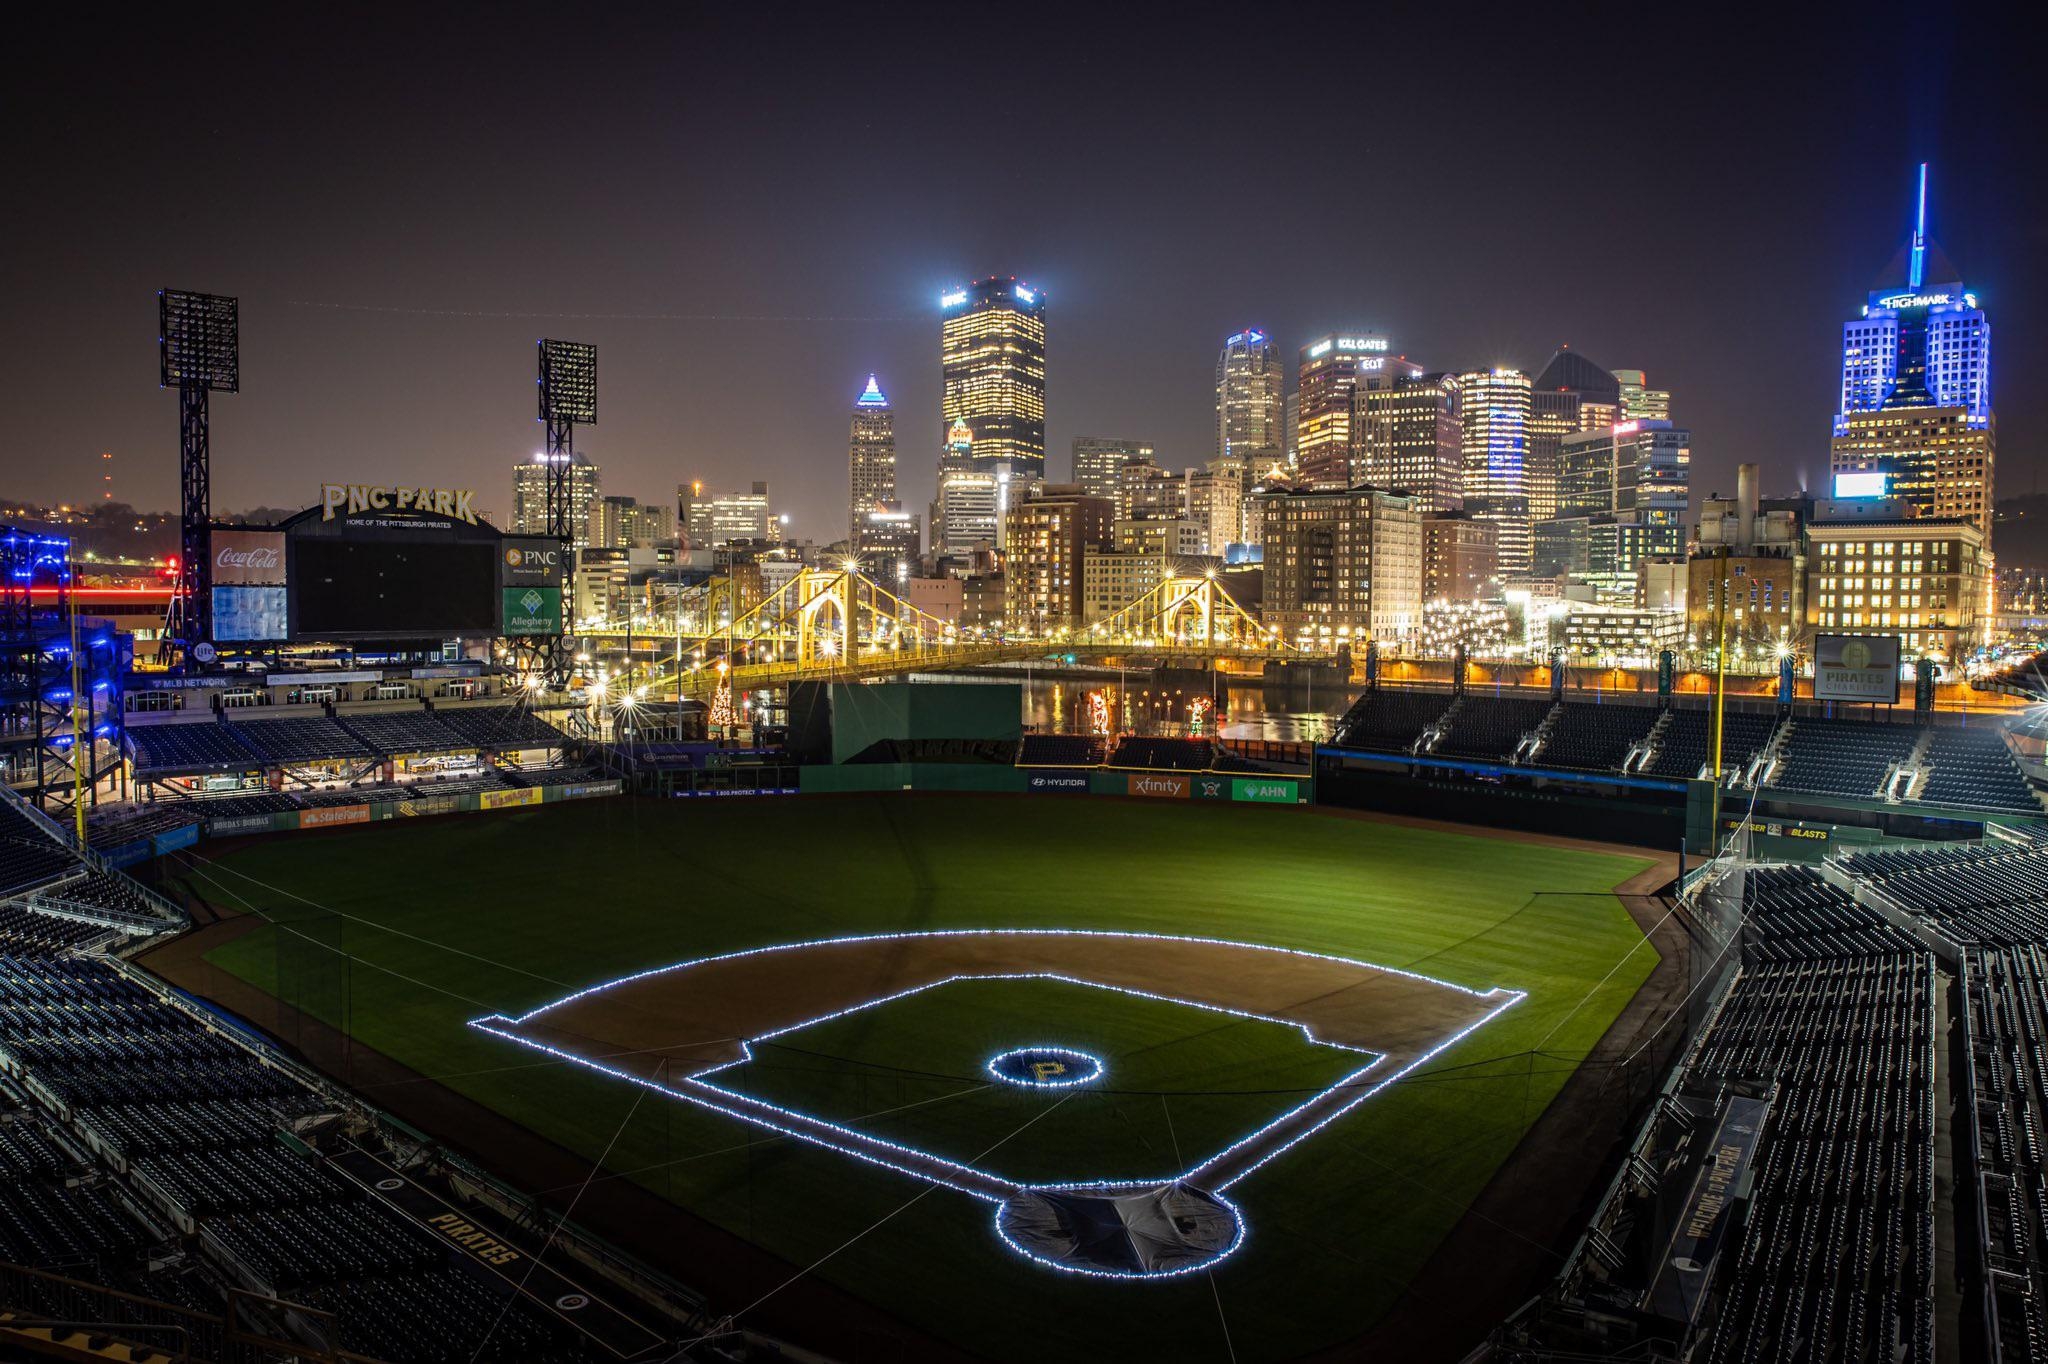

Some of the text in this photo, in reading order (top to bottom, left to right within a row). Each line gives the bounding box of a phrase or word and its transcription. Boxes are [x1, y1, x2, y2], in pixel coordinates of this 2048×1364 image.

[1881, 294, 1950, 309] HIGHMARK
[1357, 340, 1388, 351] GATES
[322, 484, 478, 527] PNC PARK
[389, 520, 427, 528] PITTSBURGH
[427, 521, 452, 529] PIRATES
[217, 547, 280, 568] Coca-Cola
[524, 551, 557, 565] PNC
[511, 617, 552, 628] Allegheny
[196, 647, 214, 657] Lite
[163, 678, 227, 688] MLB NETWORK
[1827, 671, 1885, 685] PIRATES
[1047, 777, 1087, 788] HYUNDAI
[1136, 778, 1182, 794] xfinity
[1260, 785, 1288, 798] AHN
[1790, 827, 1828, 840] BLASTS
[1716, 1144, 1743, 1167] PARK
[1708, 1164, 1735, 1184] PNC
[1686, 1192, 1725, 1239] WELCOME
[428, 1213, 520, 1265] PIRATES
